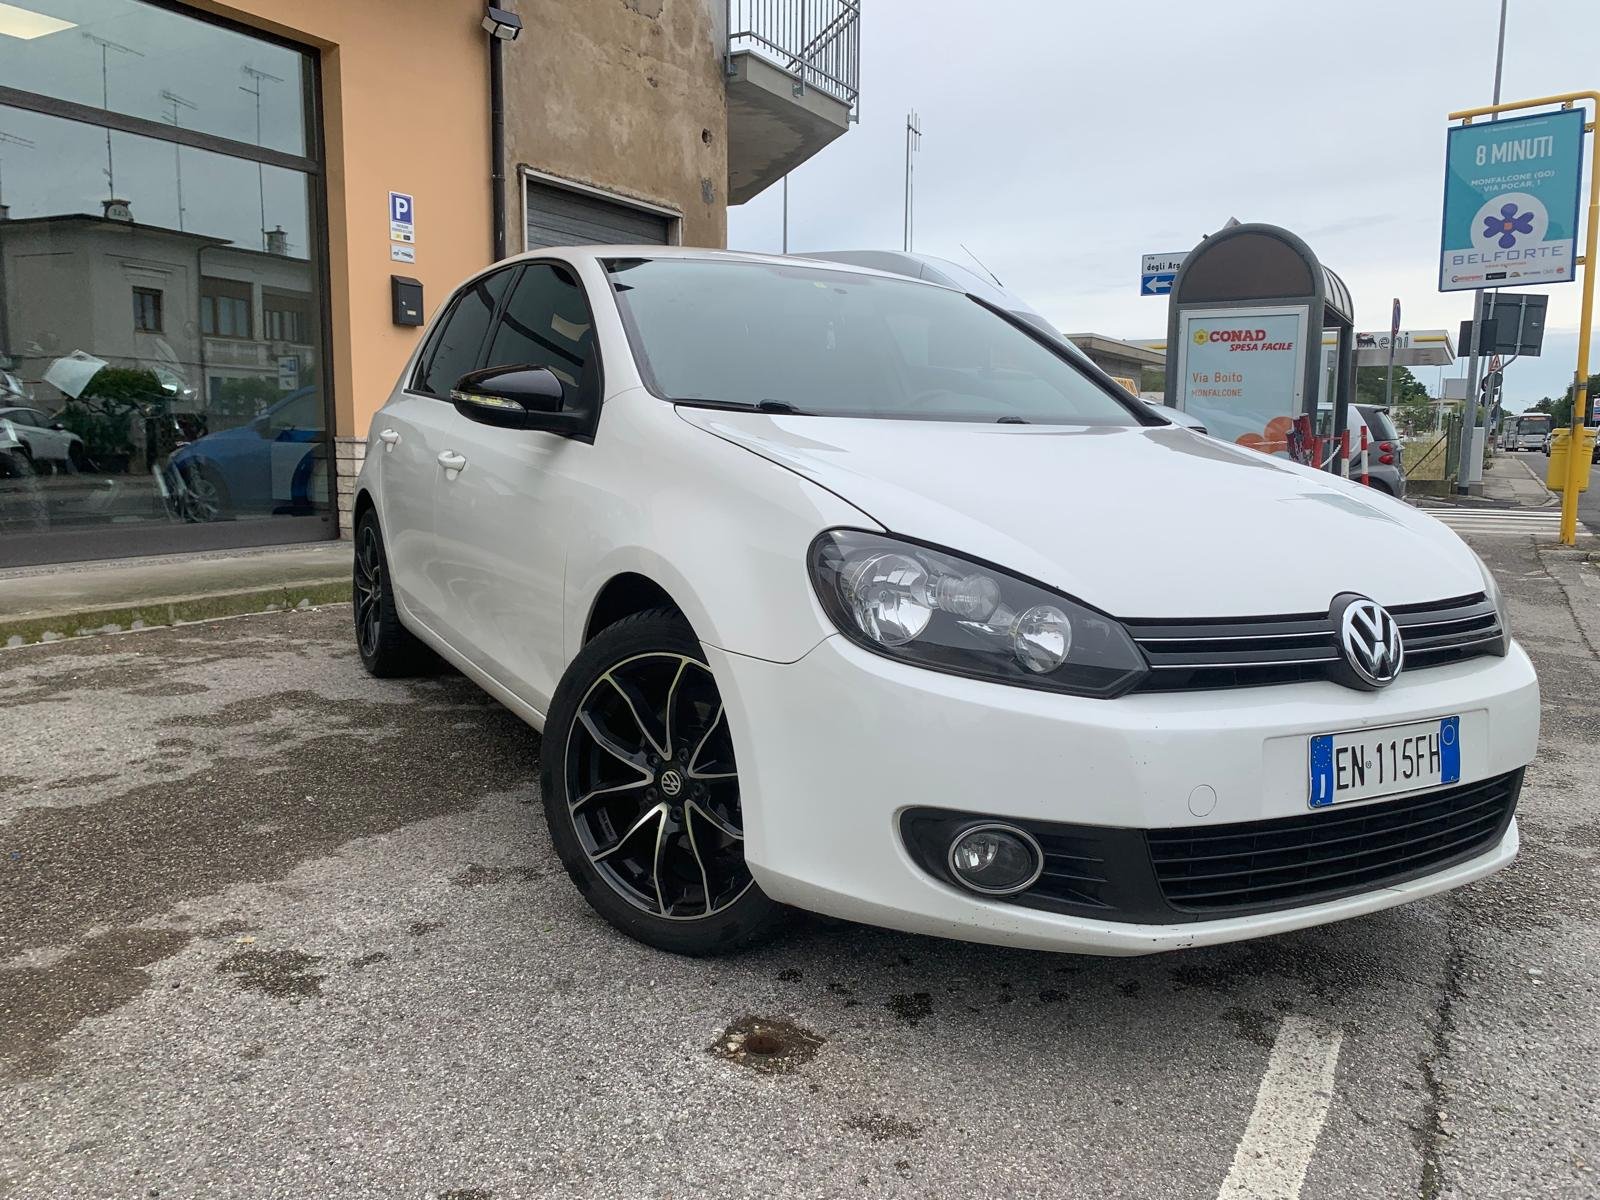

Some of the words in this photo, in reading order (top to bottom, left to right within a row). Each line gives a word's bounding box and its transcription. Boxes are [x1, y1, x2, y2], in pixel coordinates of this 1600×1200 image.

[1475, 145, 1487, 166] 8
[1491, 136, 1553, 164] MINUTI
[1471, 172, 1532, 187] MONFALCONE
[1534, 170, 1555, 179] (GO)
[1484, 184, 1499, 193] VIA
[395, 197, 409, 220] P
[1452, 246, 1564, 266] BELFORTE
[1146, 262, 1165, 272] degli
[1209, 329, 1267, 343] CONAD
[1229, 343, 1258, 352] SPESA
[1261, 342, 1294, 351] FACILE
[1192, 372, 1209, 383] Via
[1214, 372, 1243, 383] Boito
[1191, 388, 1244, 397] MONFALCONE
[1335, 744, 1366, 791] EN
[1375, 732, 1441, 785] 115FH
